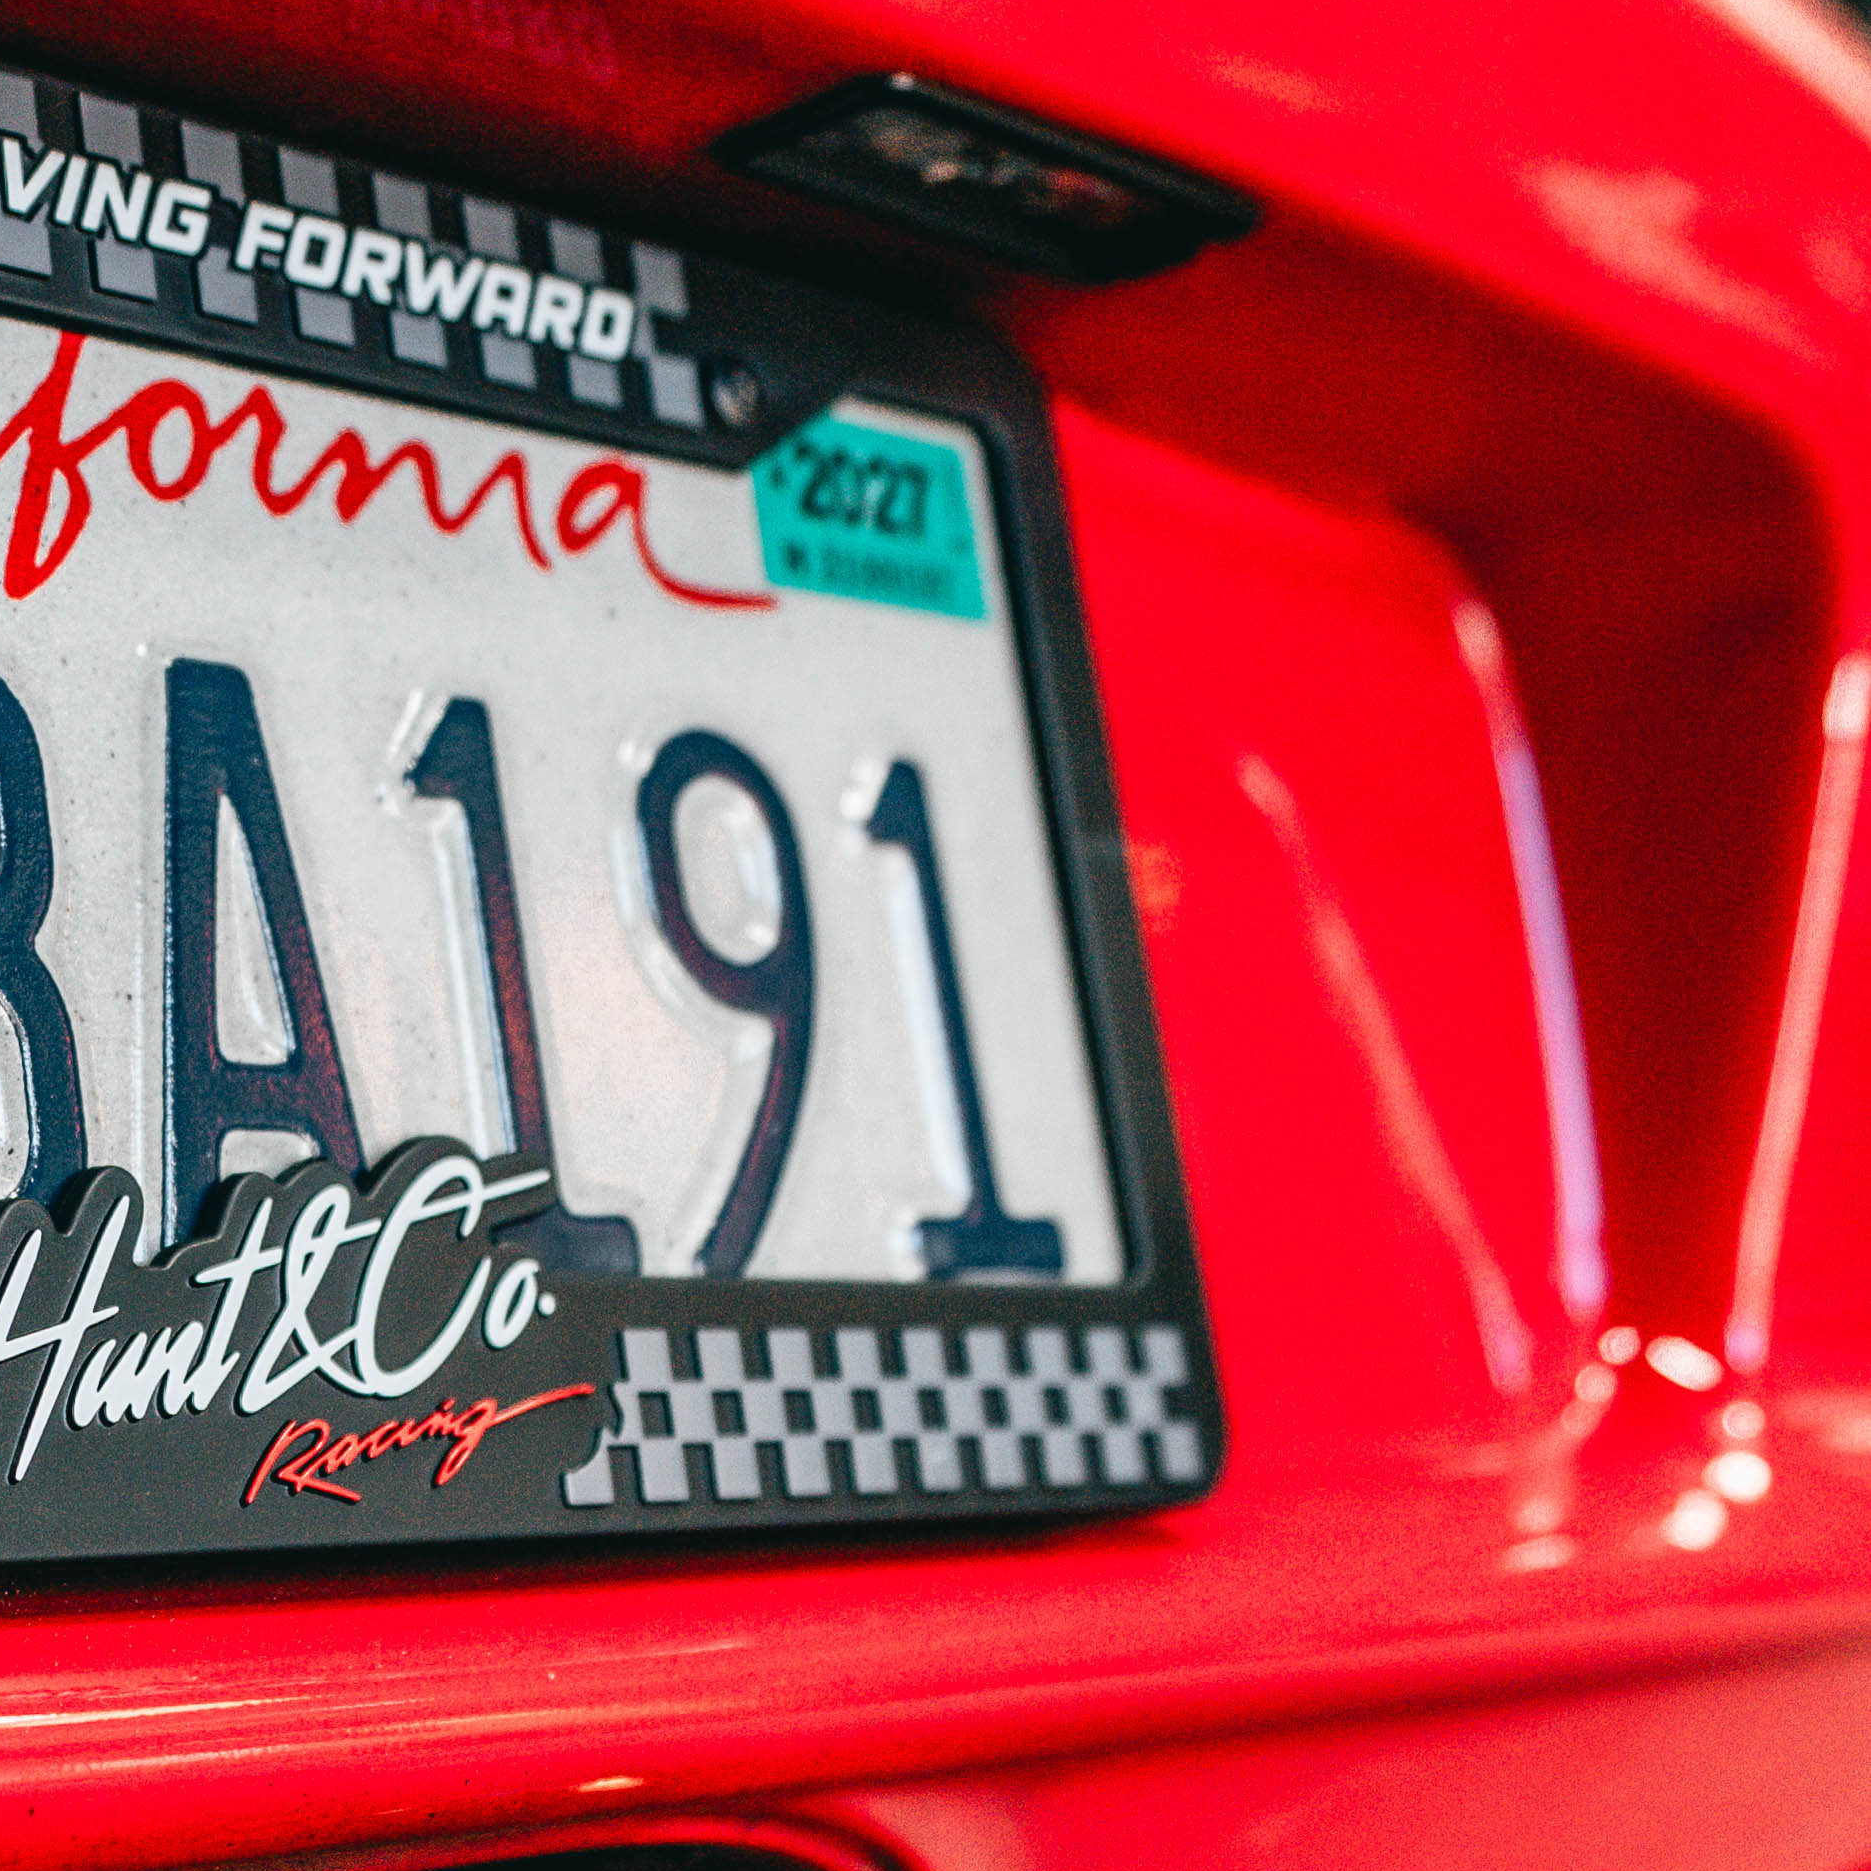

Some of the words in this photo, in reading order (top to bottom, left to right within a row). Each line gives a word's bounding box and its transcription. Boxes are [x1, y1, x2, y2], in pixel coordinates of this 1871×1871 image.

[233, 201, 635, 361] FORWARD
[790, 441, 929, 537] 2027
[246, 1383, 595, 1505] Racing
